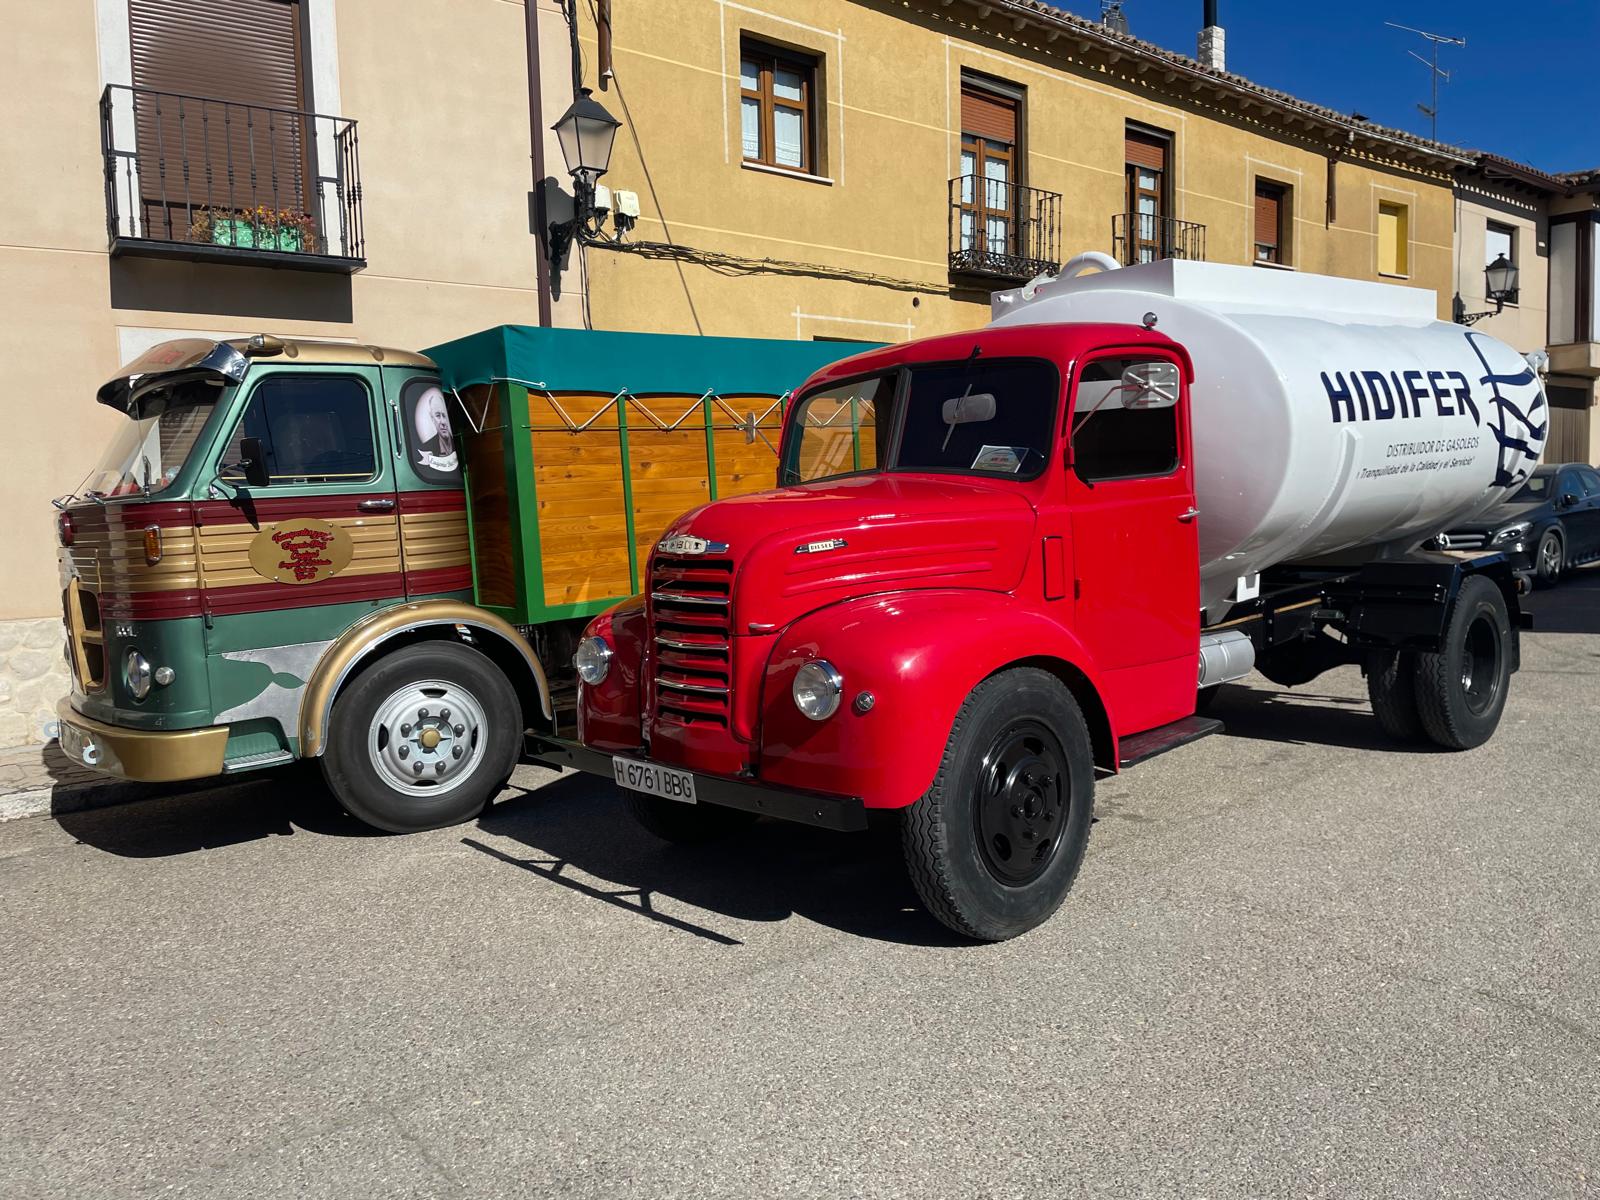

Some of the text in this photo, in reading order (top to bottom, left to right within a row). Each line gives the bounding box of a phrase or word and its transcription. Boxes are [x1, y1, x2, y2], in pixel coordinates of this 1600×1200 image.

[1320, 370, 1480, 428] HIDIFER
[1435, 440, 1446, 453] DE
[1400, 464, 1409, 474] de
[1416, 459, 1440, 471] Calidad
[615, 760, 692, 798] H 6761 BBG
